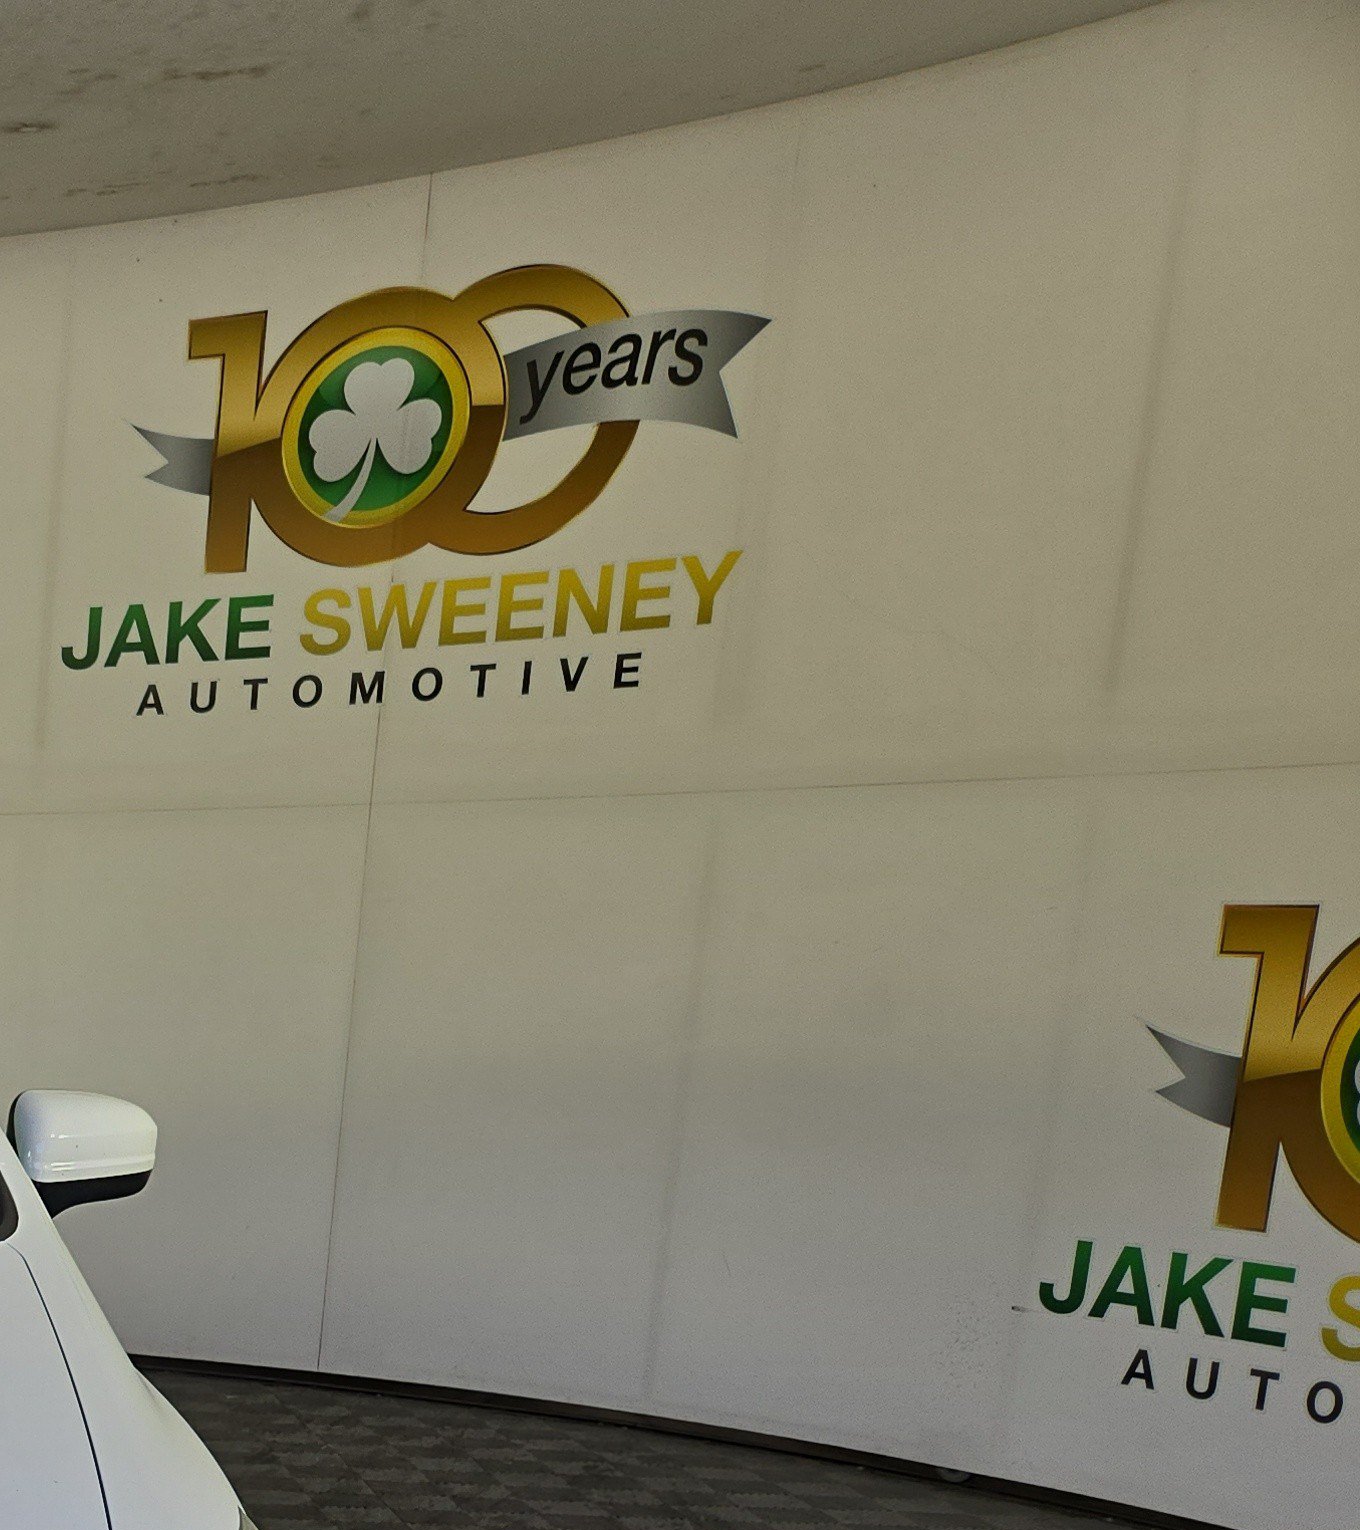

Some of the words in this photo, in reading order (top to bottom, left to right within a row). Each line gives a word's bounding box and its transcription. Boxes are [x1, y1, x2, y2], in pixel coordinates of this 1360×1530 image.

[187, 263, 641, 575] 100
[518, 326, 708, 425] years
[61, 593, 275, 671] JAKE
[298, 549, 743, 657] SWEENEY
[134, 651, 642, 717] AUTOMOTIVE
[1039, 1239, 1297, 1349] JAKE
